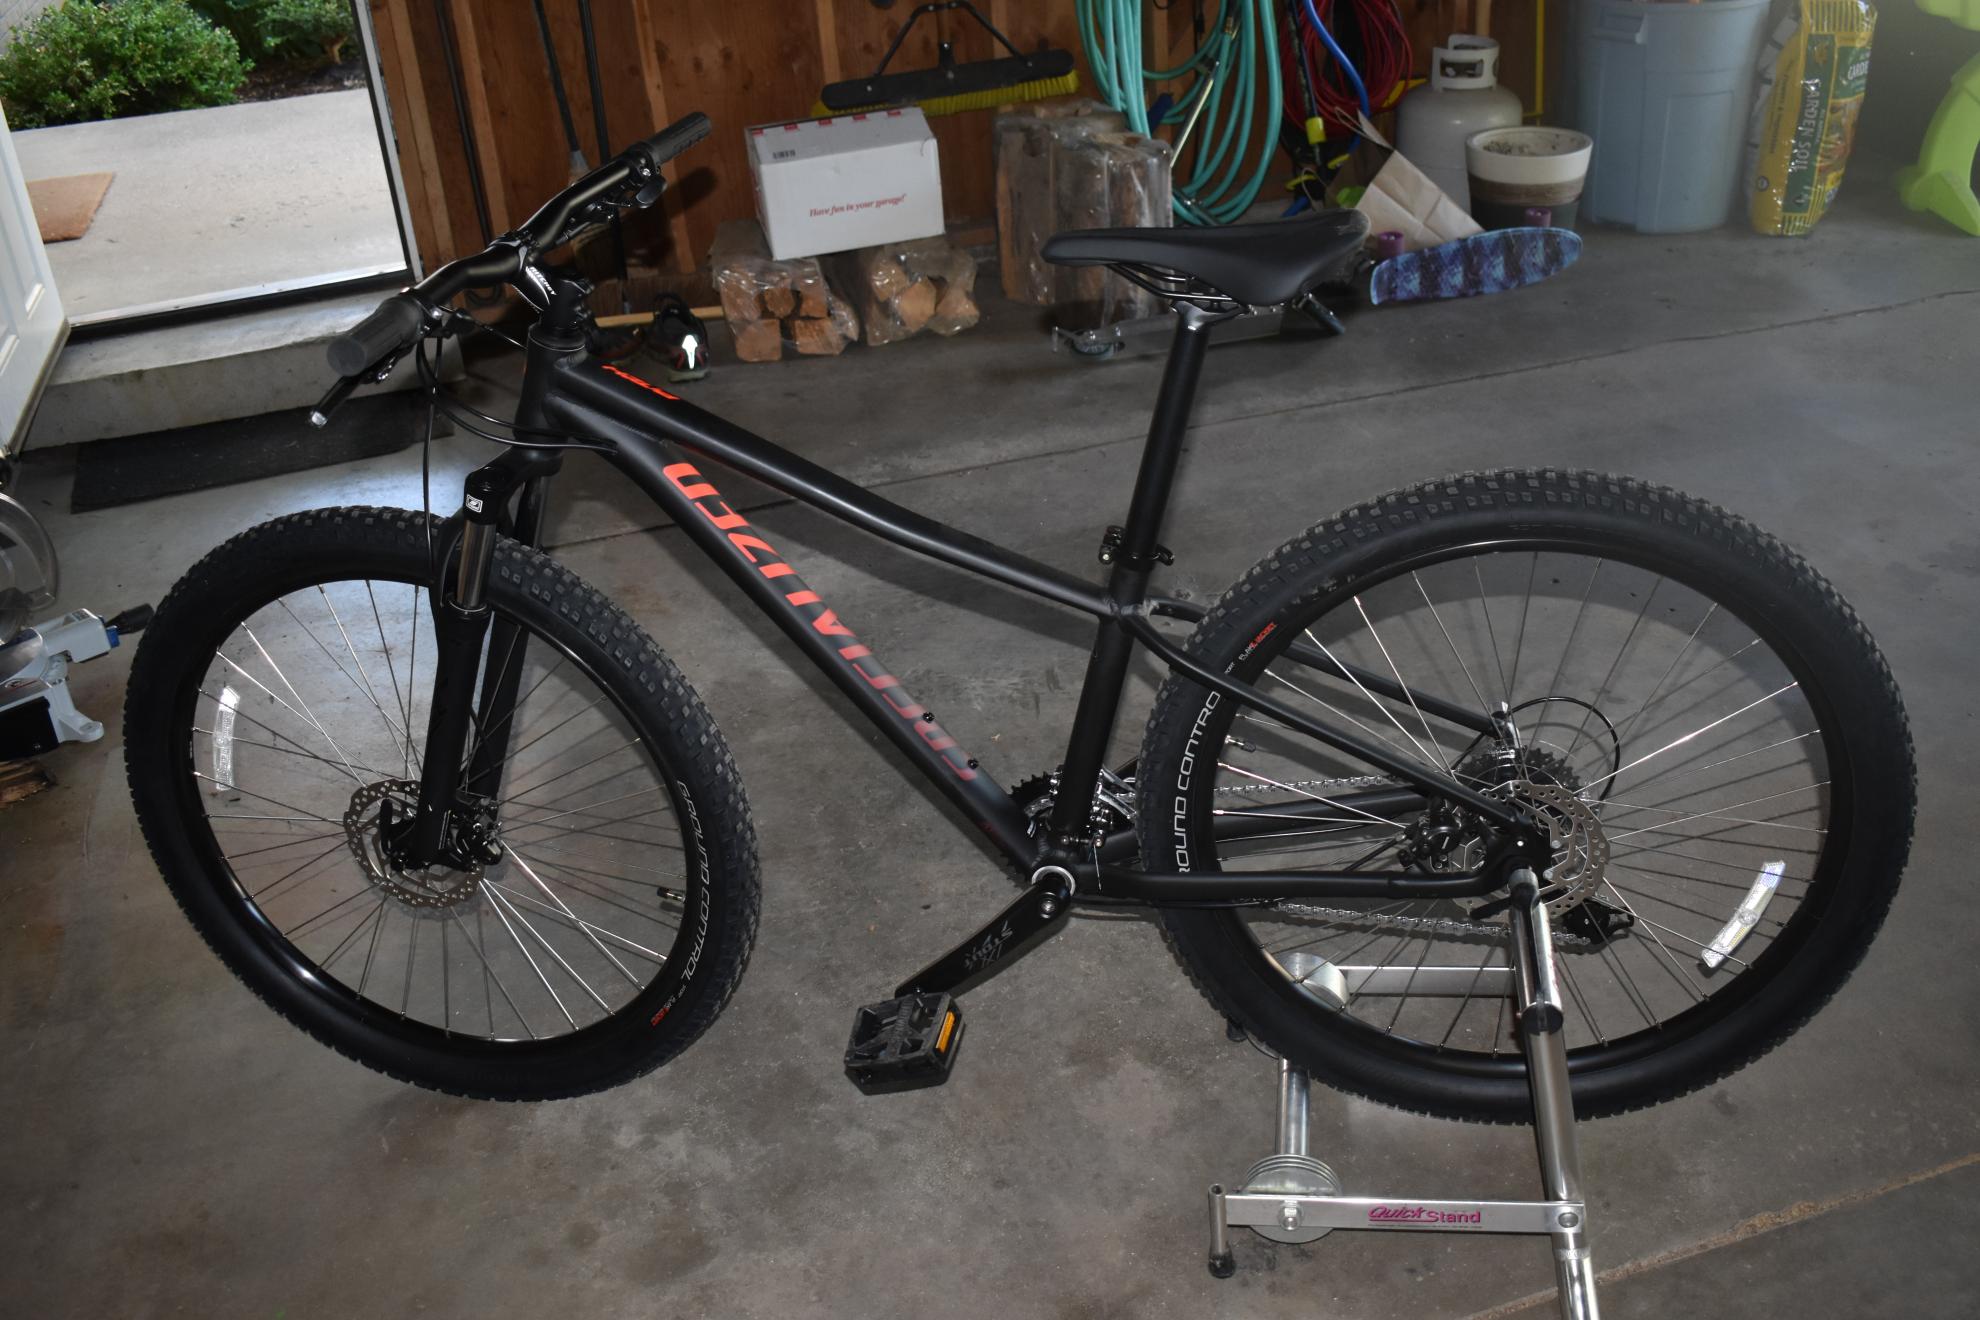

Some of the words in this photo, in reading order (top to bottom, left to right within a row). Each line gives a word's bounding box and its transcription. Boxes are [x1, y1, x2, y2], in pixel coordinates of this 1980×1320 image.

[1791, 141, 1812, 172] SOIL
[809, 207, 830, 217] Have
[829, 204, 845, 216] fun
[846, 201, 855, 211] in
[854, 199, 873, 212] your
[529, 266, 557, 296] RITCHEY
[662, 462, 979, 782] SPECIALIZED
[1177, 690, 1221, 791] CONTRO
[676, 780, 711, 886] GROUND
[680, 887, 711, 981] CONTROL
